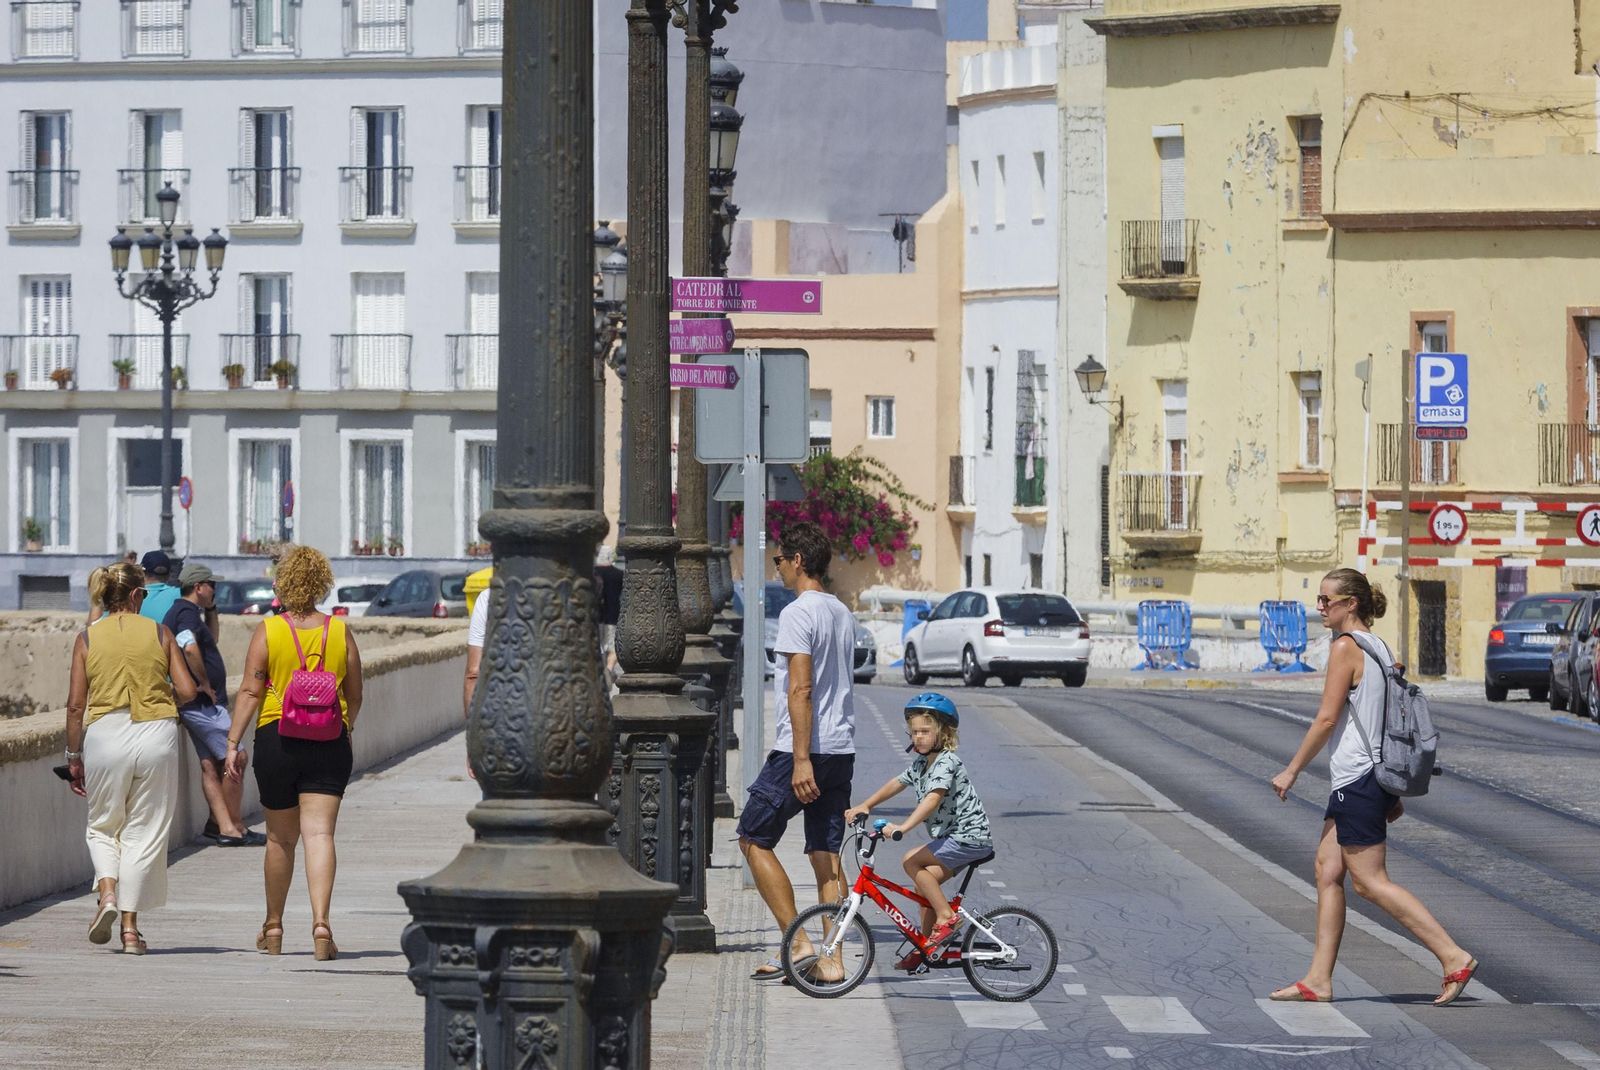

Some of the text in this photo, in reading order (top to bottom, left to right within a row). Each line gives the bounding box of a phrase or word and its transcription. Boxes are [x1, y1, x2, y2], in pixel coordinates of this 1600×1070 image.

[677, 282, 741, 297] CATEDRAL
[677, 299, 757, 309] TORRE DE PONIENTE
[690, 369, 702, 384] DEL
[1420, 356, 1455, 403] P
[1422, 408, 1461, 417] emasa
